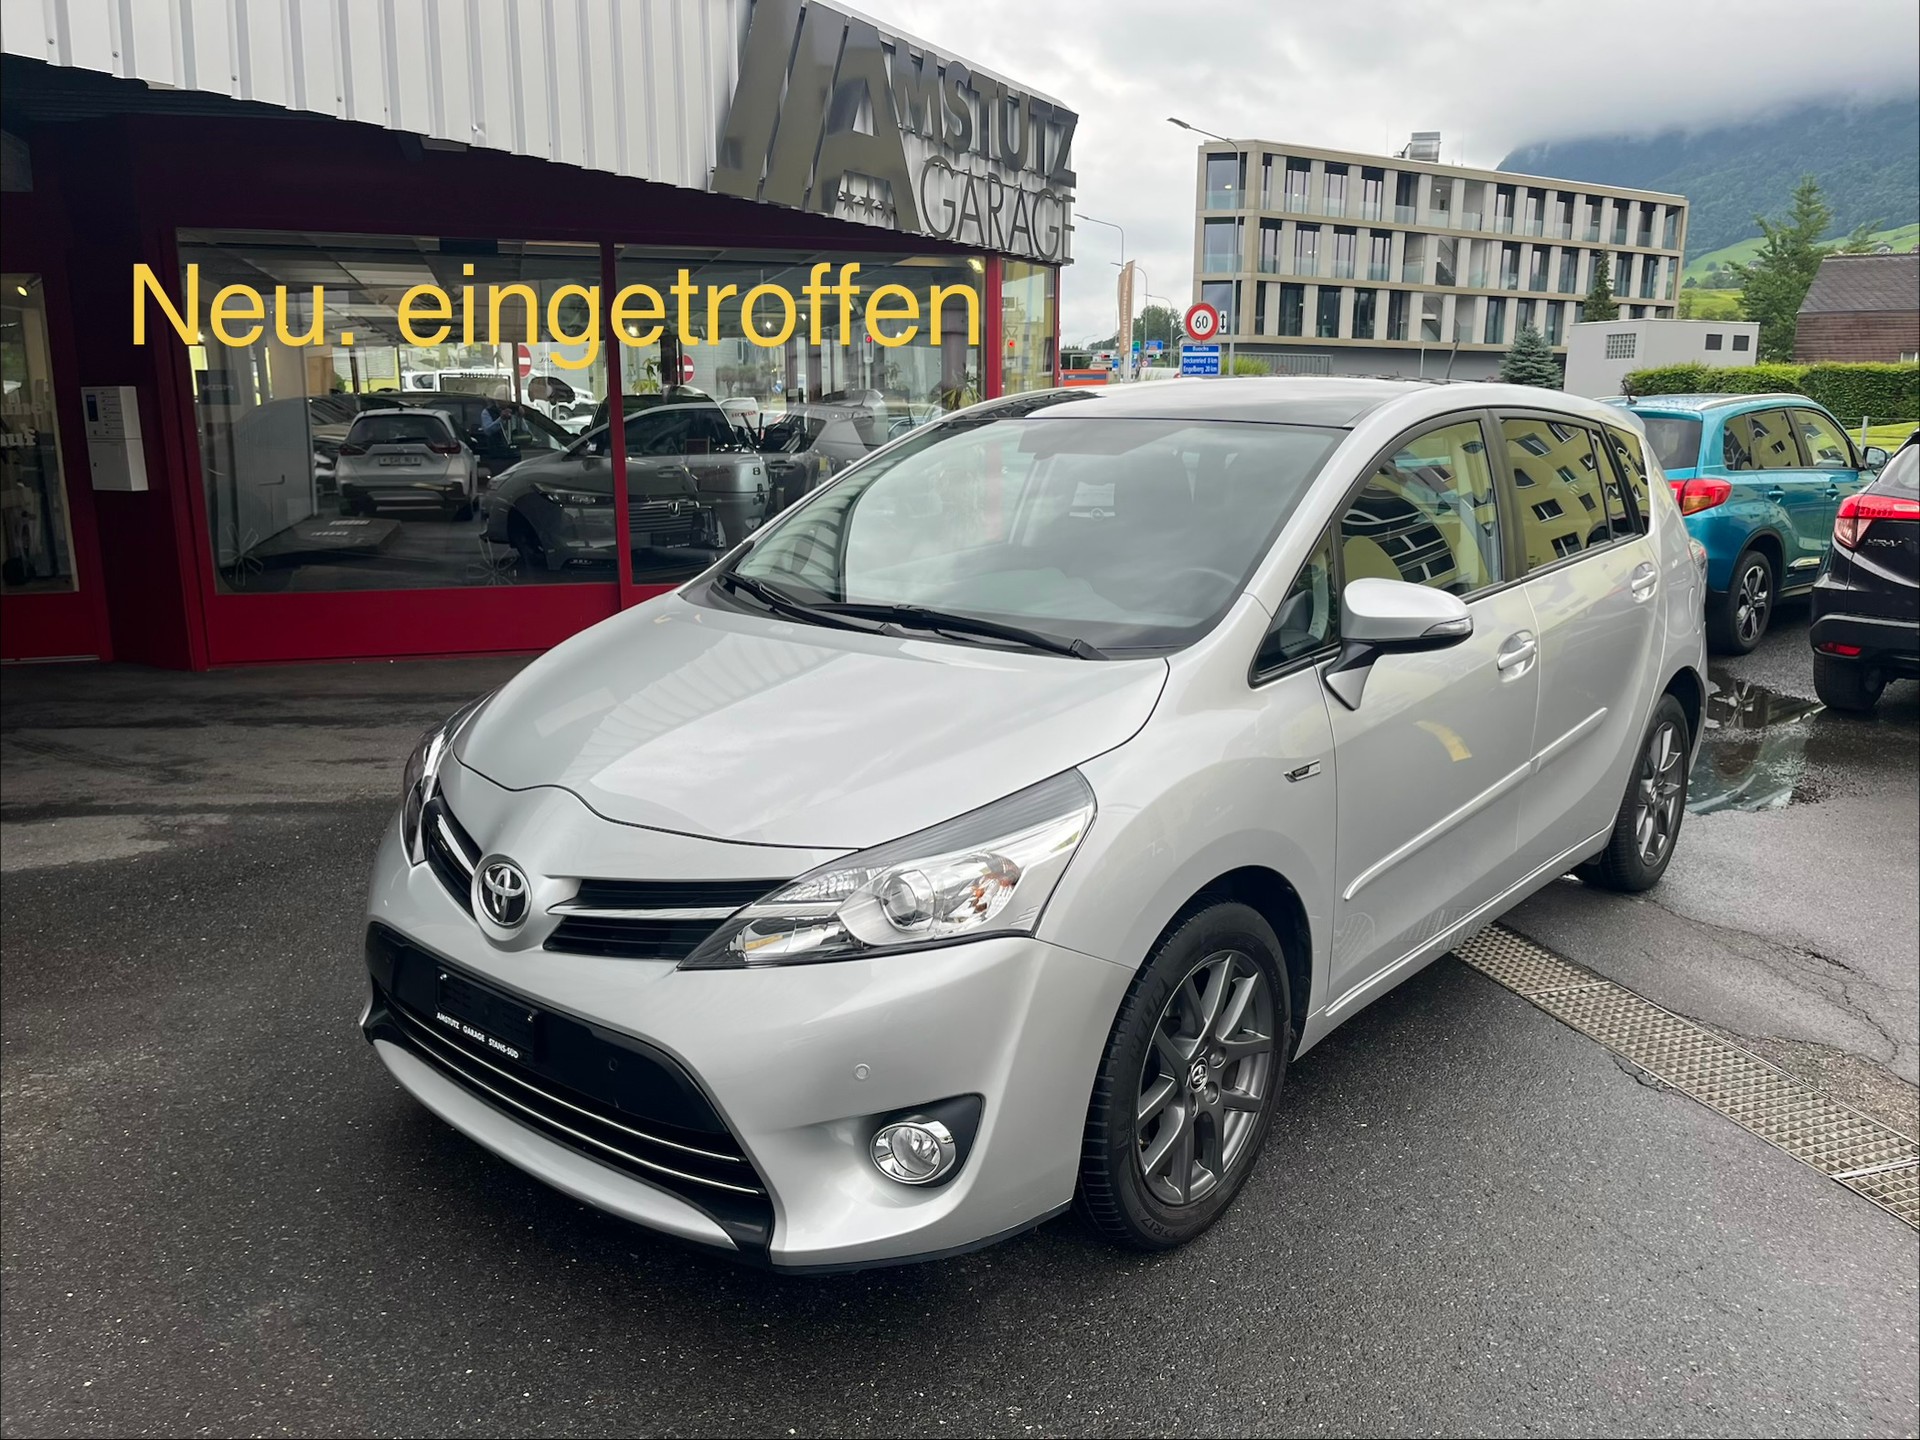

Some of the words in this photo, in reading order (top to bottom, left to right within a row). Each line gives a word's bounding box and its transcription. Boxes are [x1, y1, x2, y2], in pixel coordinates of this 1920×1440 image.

[920, 155, 1076, 264] GARAGE
[1195, 315, 1209, 329] 60
[1183, 365, 1204, 374] Engelberg
[437, 1012, 460, 1029] AMSTUTZ
[462, 1025, 485, 1042] GARAGE
